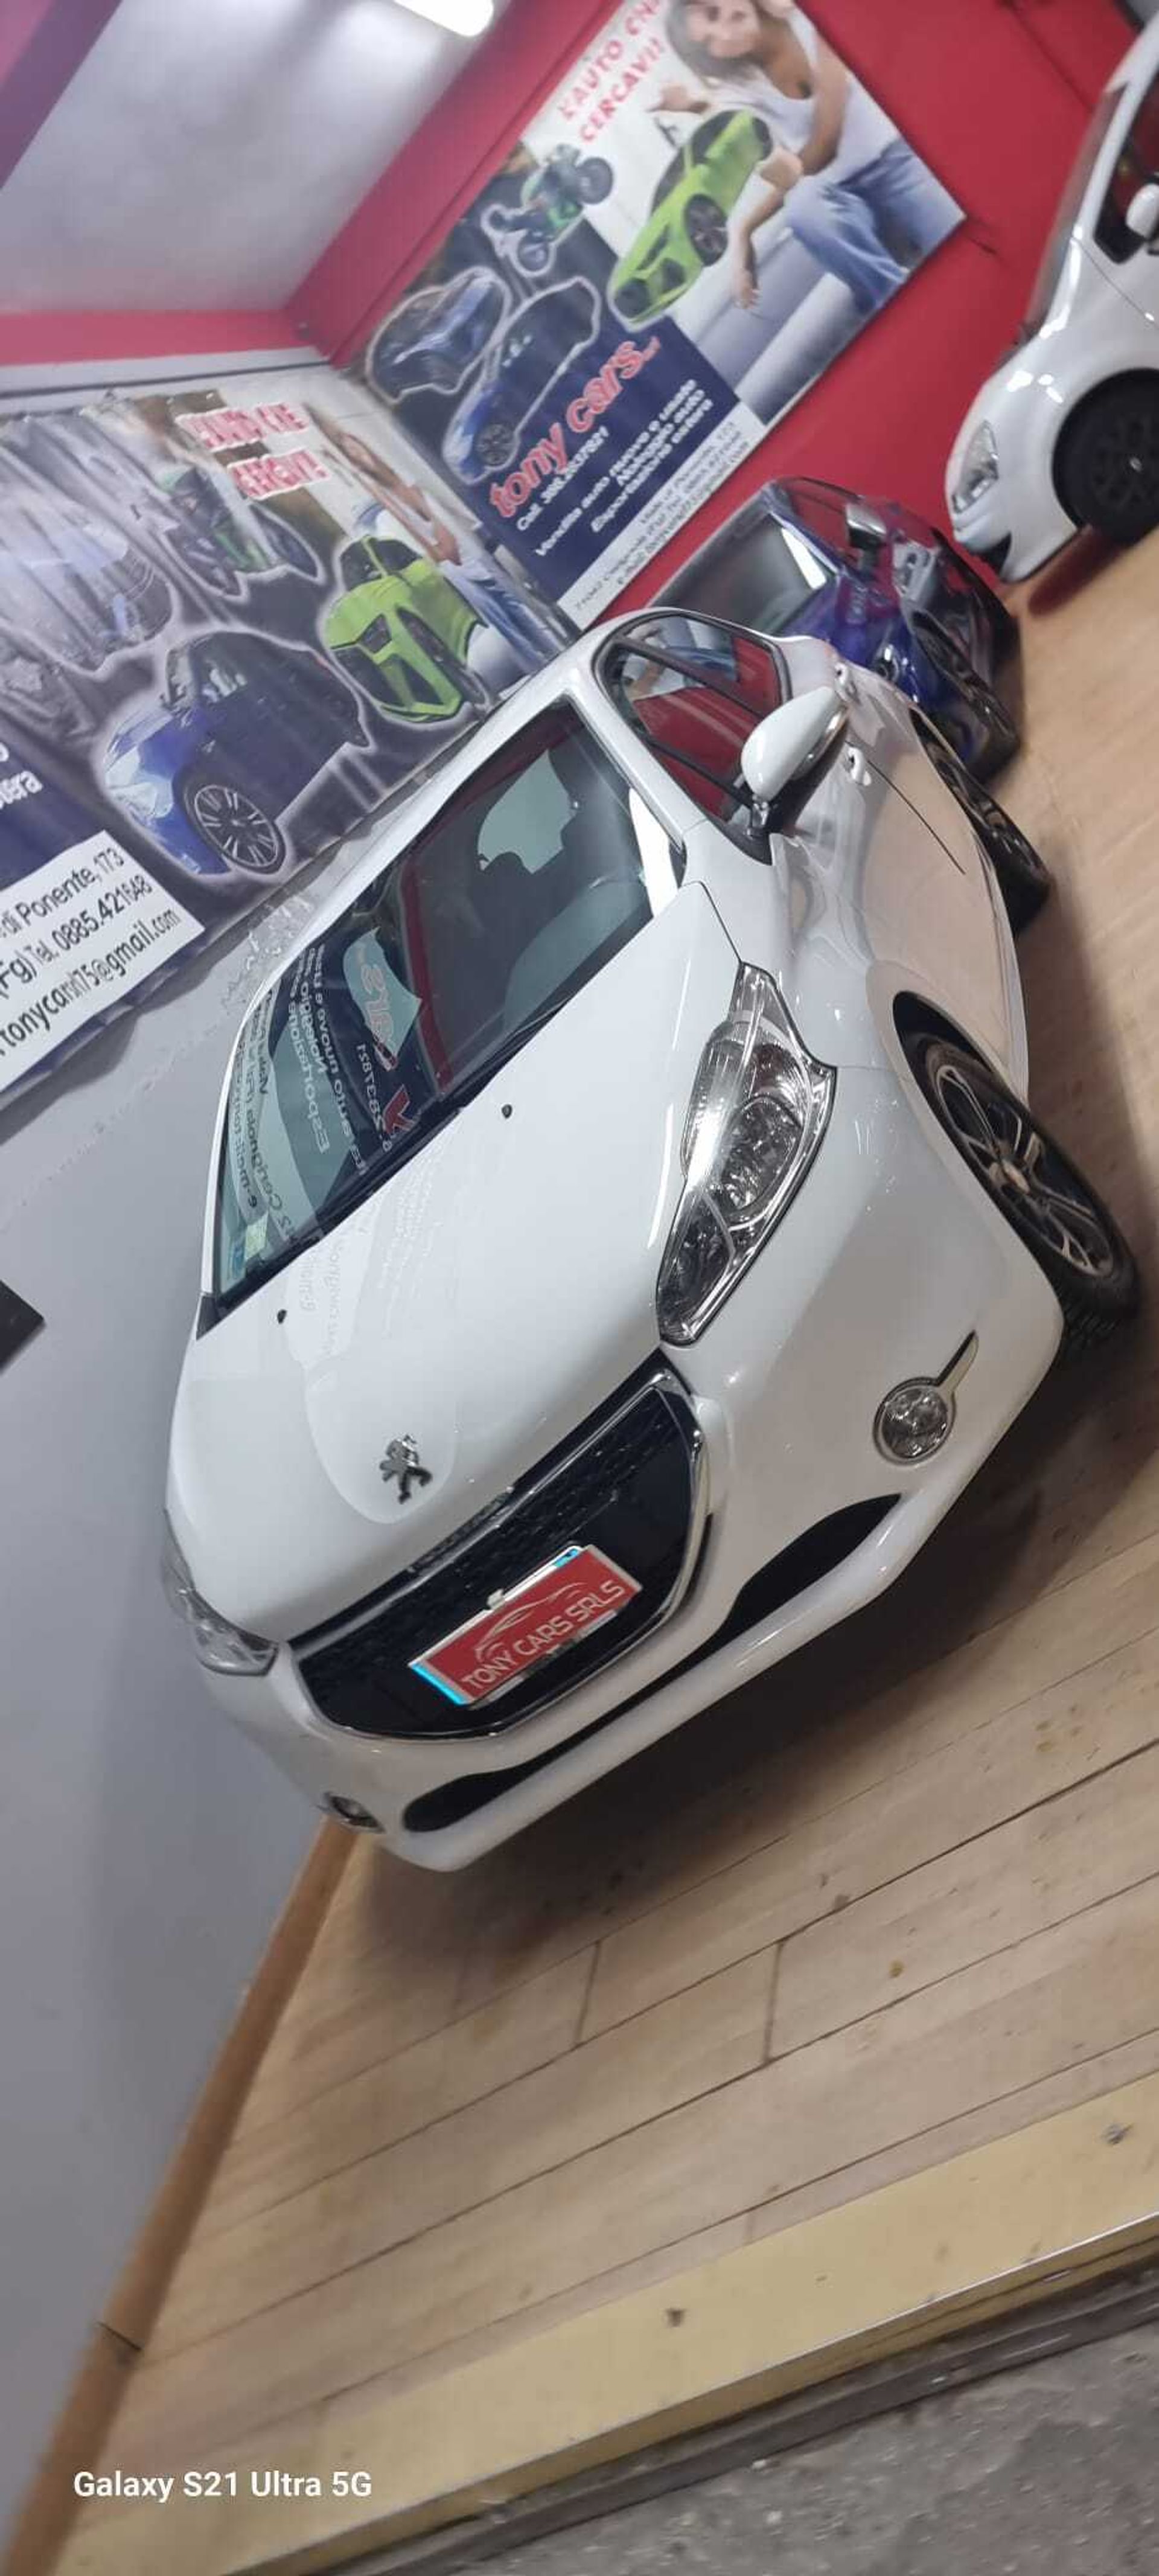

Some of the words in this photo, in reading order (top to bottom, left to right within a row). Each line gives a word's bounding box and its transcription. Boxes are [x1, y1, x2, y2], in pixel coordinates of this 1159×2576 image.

[490, 423, 568, 517] tony
[566, 340, 643, 433] cars
[15, 867, 103, 925] Ponente,
[94, 847, 124, 875] 173
[461, 1650, 518, 1690] TONY
[512, 1615, 574, 1657] CARS
[564, 1579, 626, 1623] SRLS
